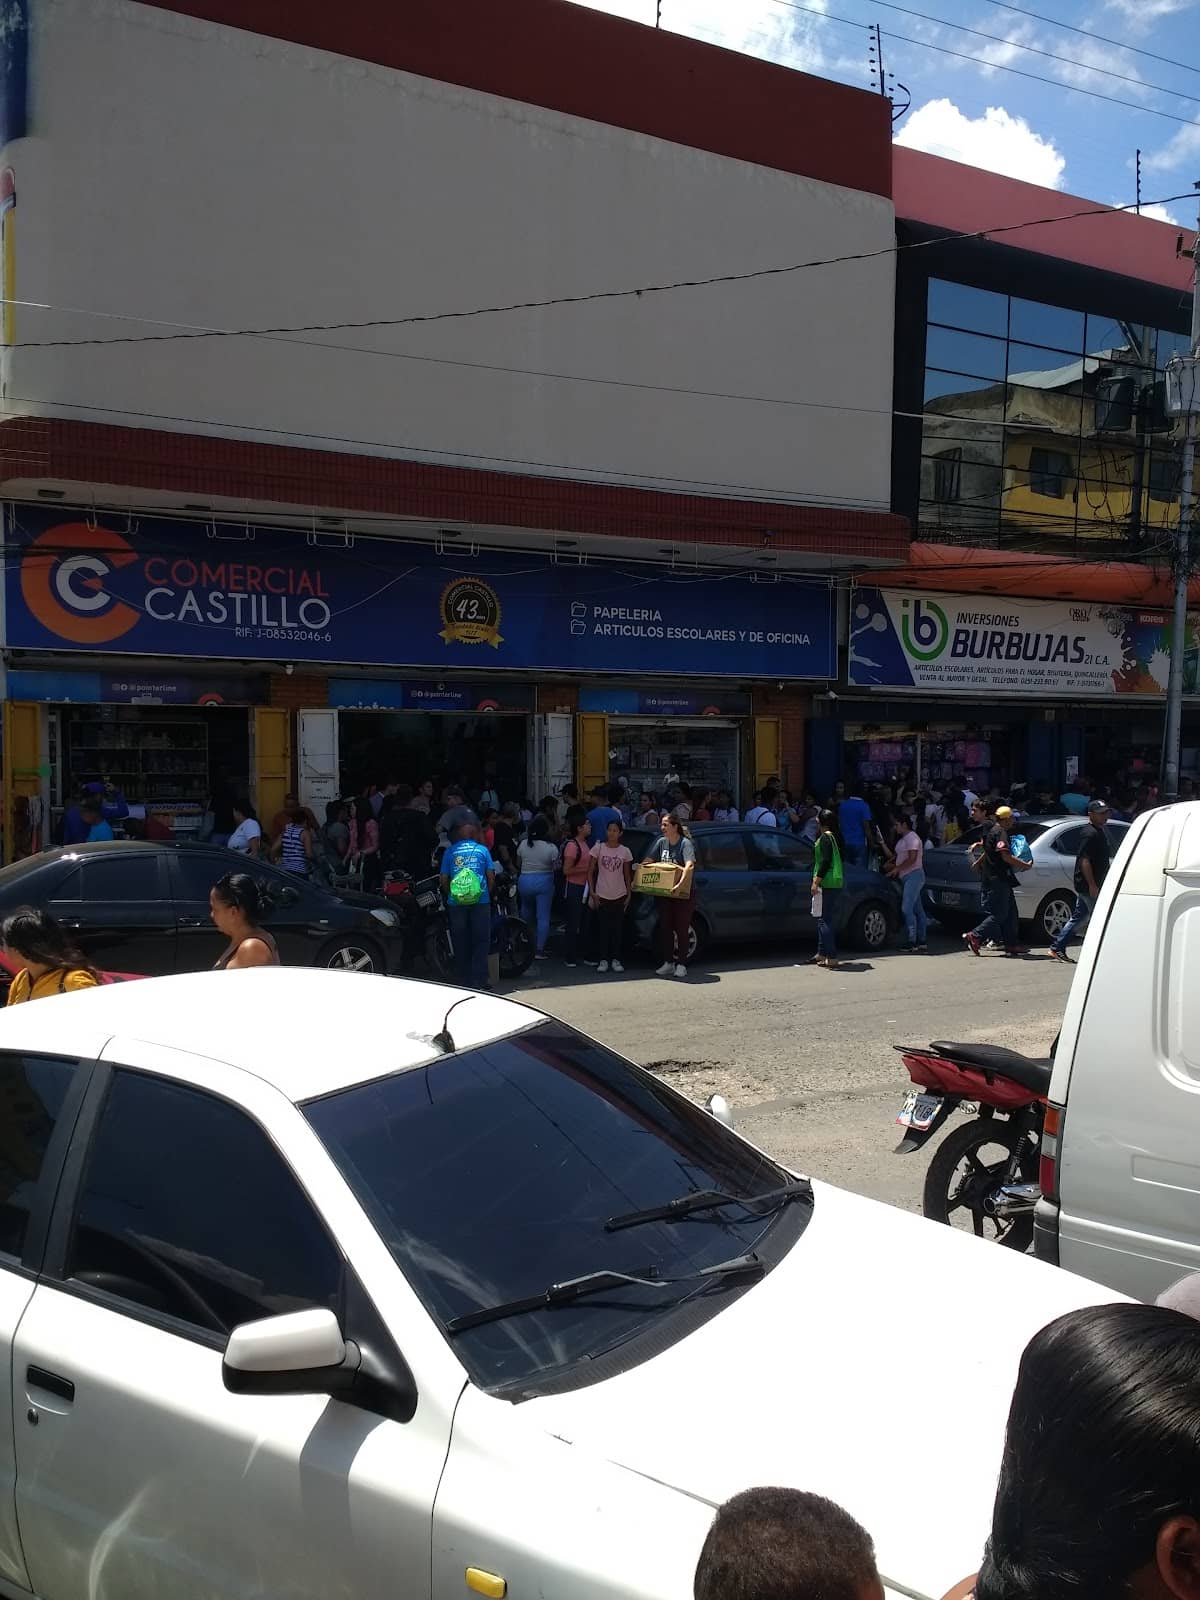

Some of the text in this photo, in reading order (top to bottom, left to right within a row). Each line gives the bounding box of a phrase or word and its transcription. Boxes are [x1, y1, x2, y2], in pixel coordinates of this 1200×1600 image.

[144, 557, 330, 598] COMERCIAL
[144, 587, 331, 629] CASTILLO
[456, 599, 479, 620] 43
[593, 606, 663, 622] PAPELERIA
[956, 612, 1020, 627] INVERSIONES
[235, 627, 332, 642] RIF: J-08532046-6
[593, 623, 811, 645] ARTICULOS ESCOLARES Y DE OFICINA
[950, 628, 1086, 663] BURBUJAS
